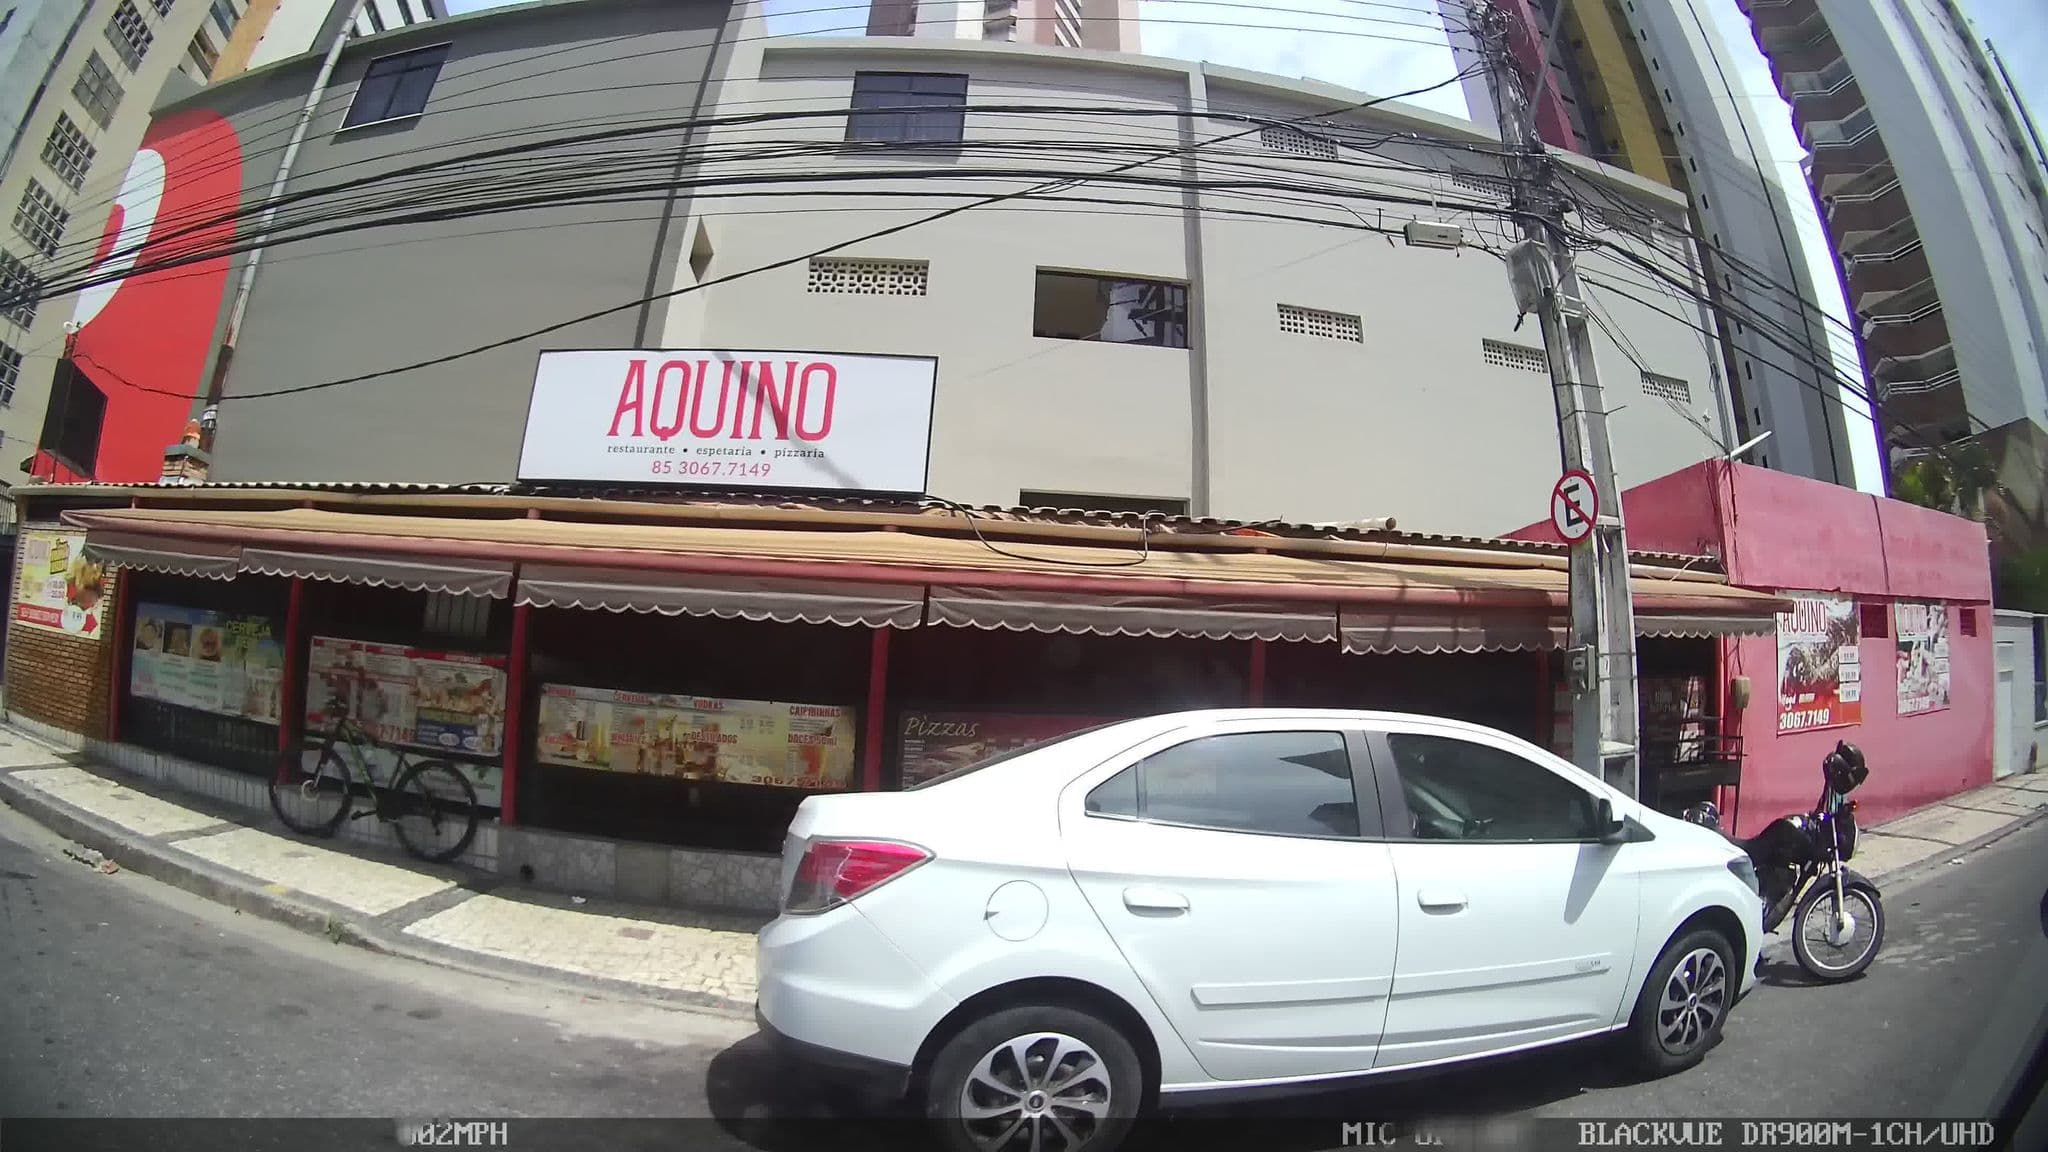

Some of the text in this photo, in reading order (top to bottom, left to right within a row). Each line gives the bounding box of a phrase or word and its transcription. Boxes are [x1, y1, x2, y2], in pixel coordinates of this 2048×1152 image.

[606, 359, 838, 442] AQUINO
[607, 443, 826, 460] restaurante espetaria pizzaria
[651, 460, 771, 478] 85 3067.7149
[903, 714, 980, 738] Pizzas
[1778, 708, 1831, 731] 3067.7149
